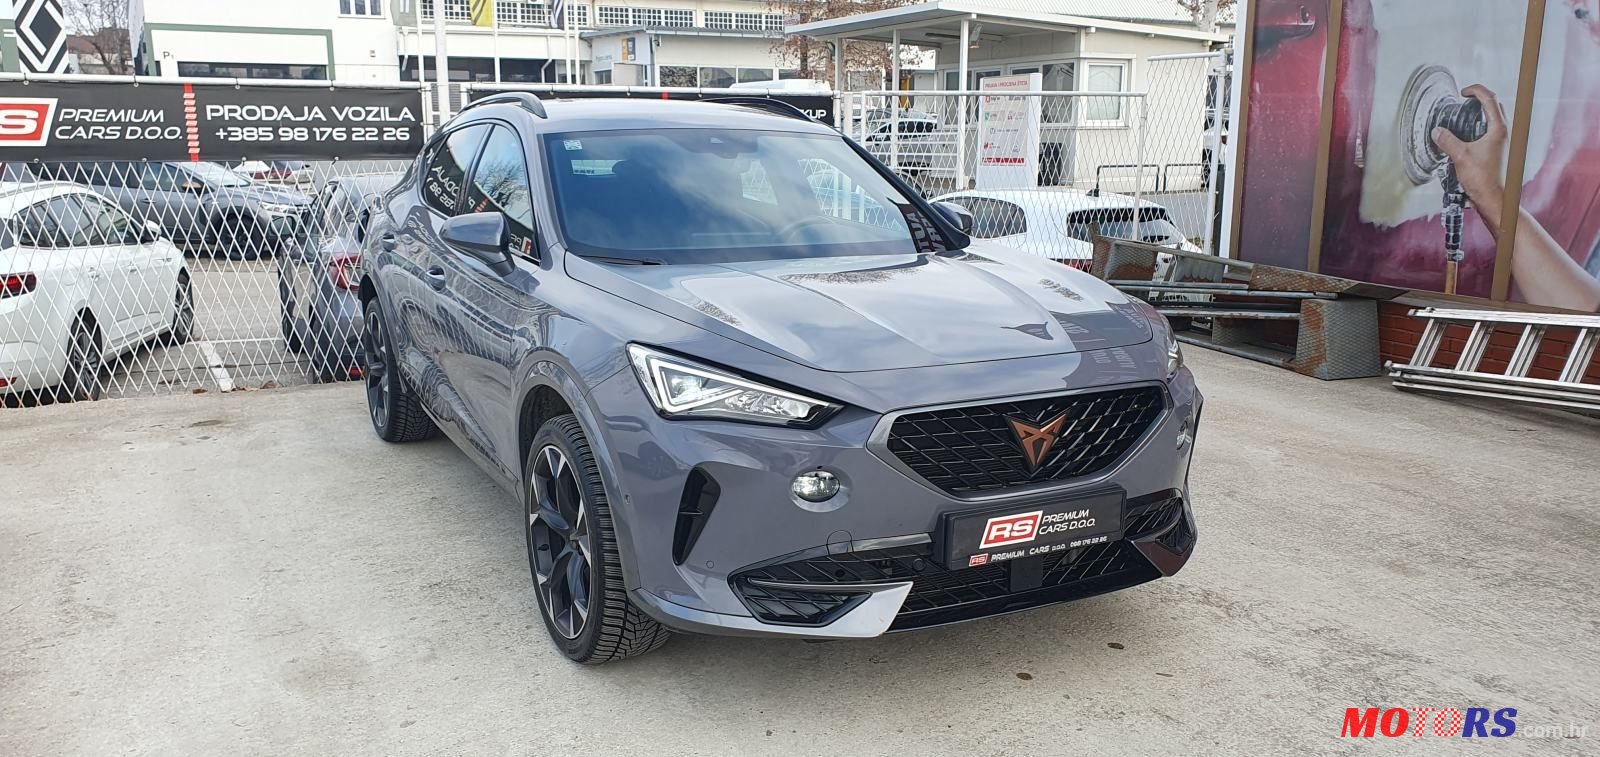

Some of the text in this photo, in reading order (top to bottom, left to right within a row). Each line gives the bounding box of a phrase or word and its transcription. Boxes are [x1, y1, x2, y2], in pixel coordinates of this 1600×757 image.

[59, 108, 165, 123] PREMIUM
[206, 105, 416, 122] PRODAJA VOZILA
[54, 126, 183, 140] CARS D.O.O.
[215, 126, 410, 141] +385 98 176 22 26
[1042, 509, 1090, 524] PREMIUM
[988, 519, 1034, 541] RS
[1039, 518, 1096, 535] CARS D.O.O.
[991, 550, 1025, 562] PREMIUM
[1029, 545, 1050, 555] CARS
